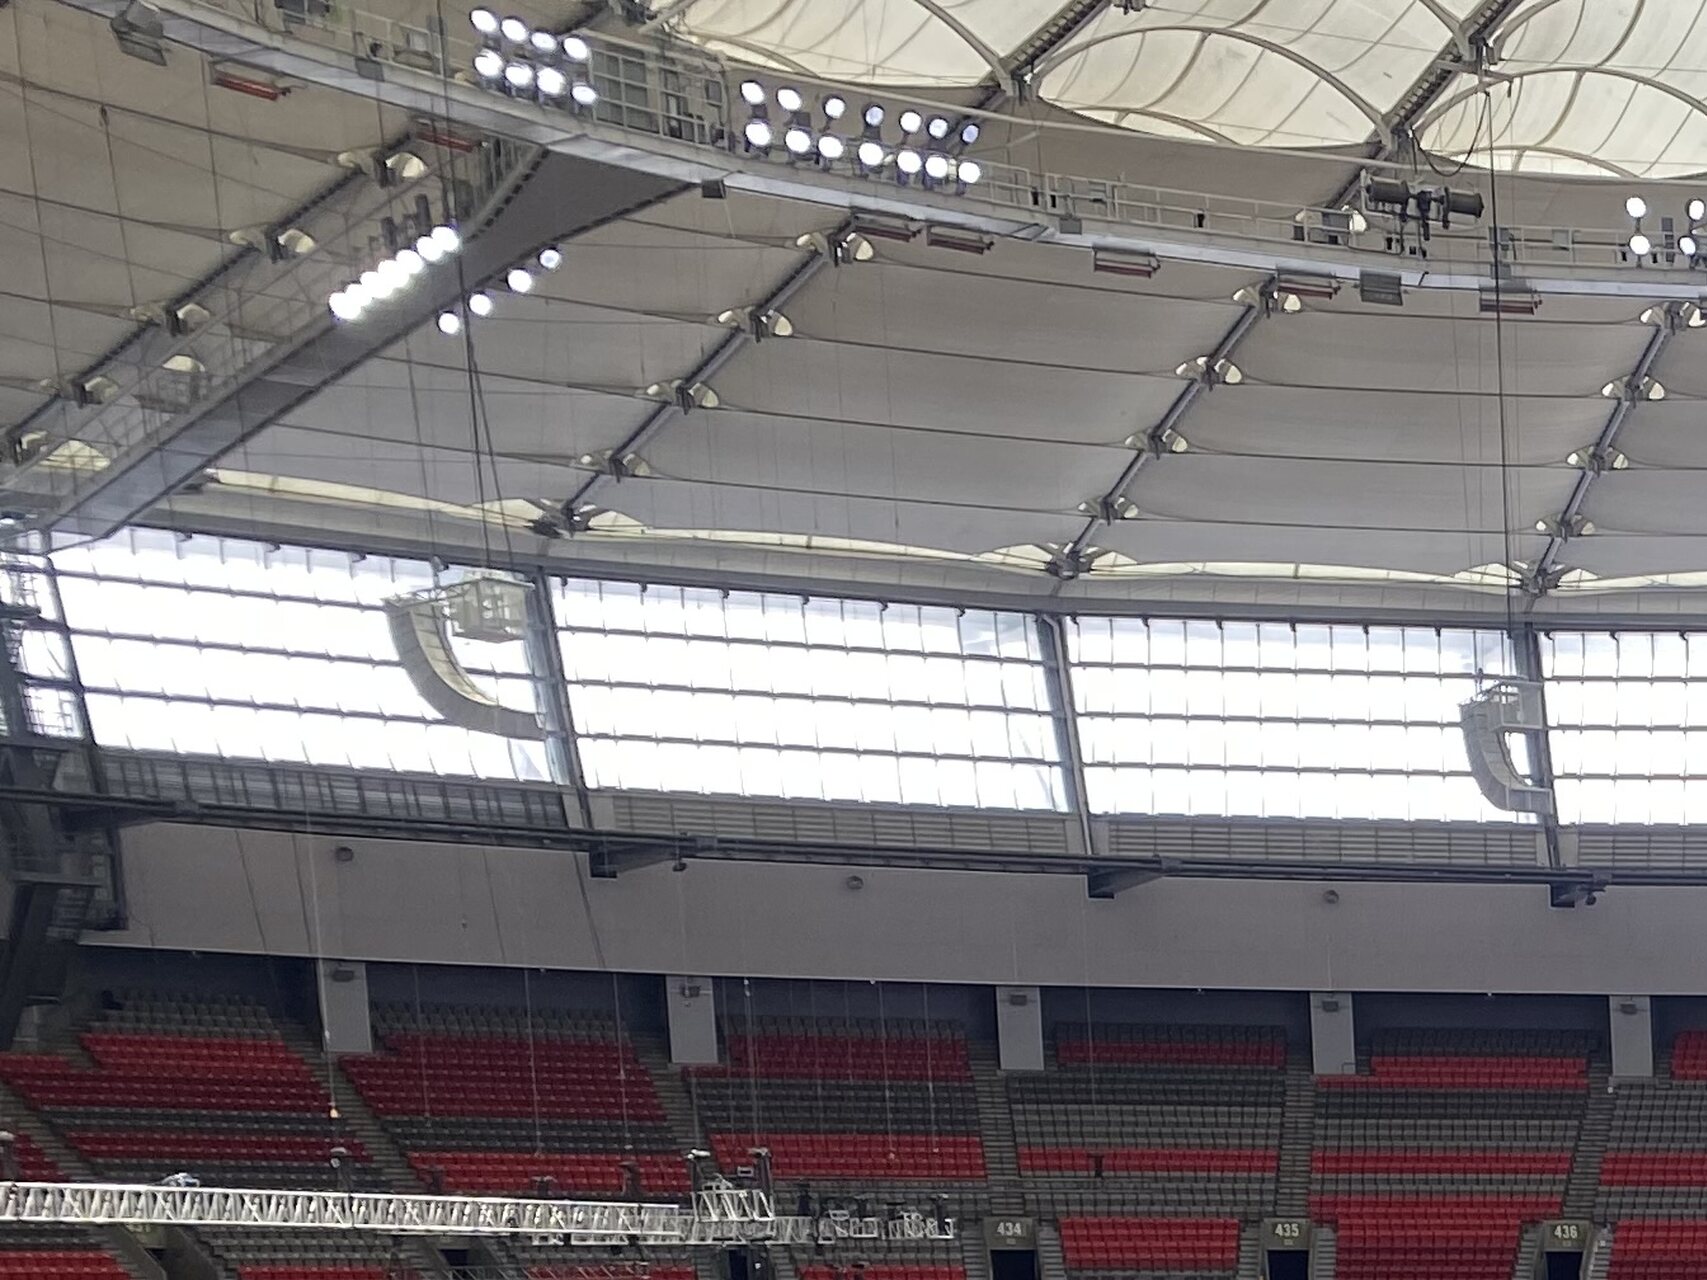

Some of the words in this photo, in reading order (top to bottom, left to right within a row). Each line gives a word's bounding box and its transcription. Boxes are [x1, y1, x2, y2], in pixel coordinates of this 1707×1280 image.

[997, 1222, 1022, 1236] 434
[1275, 1223, 1299, 1237] 435
[1554, 1225, 1578, 1239] 436
